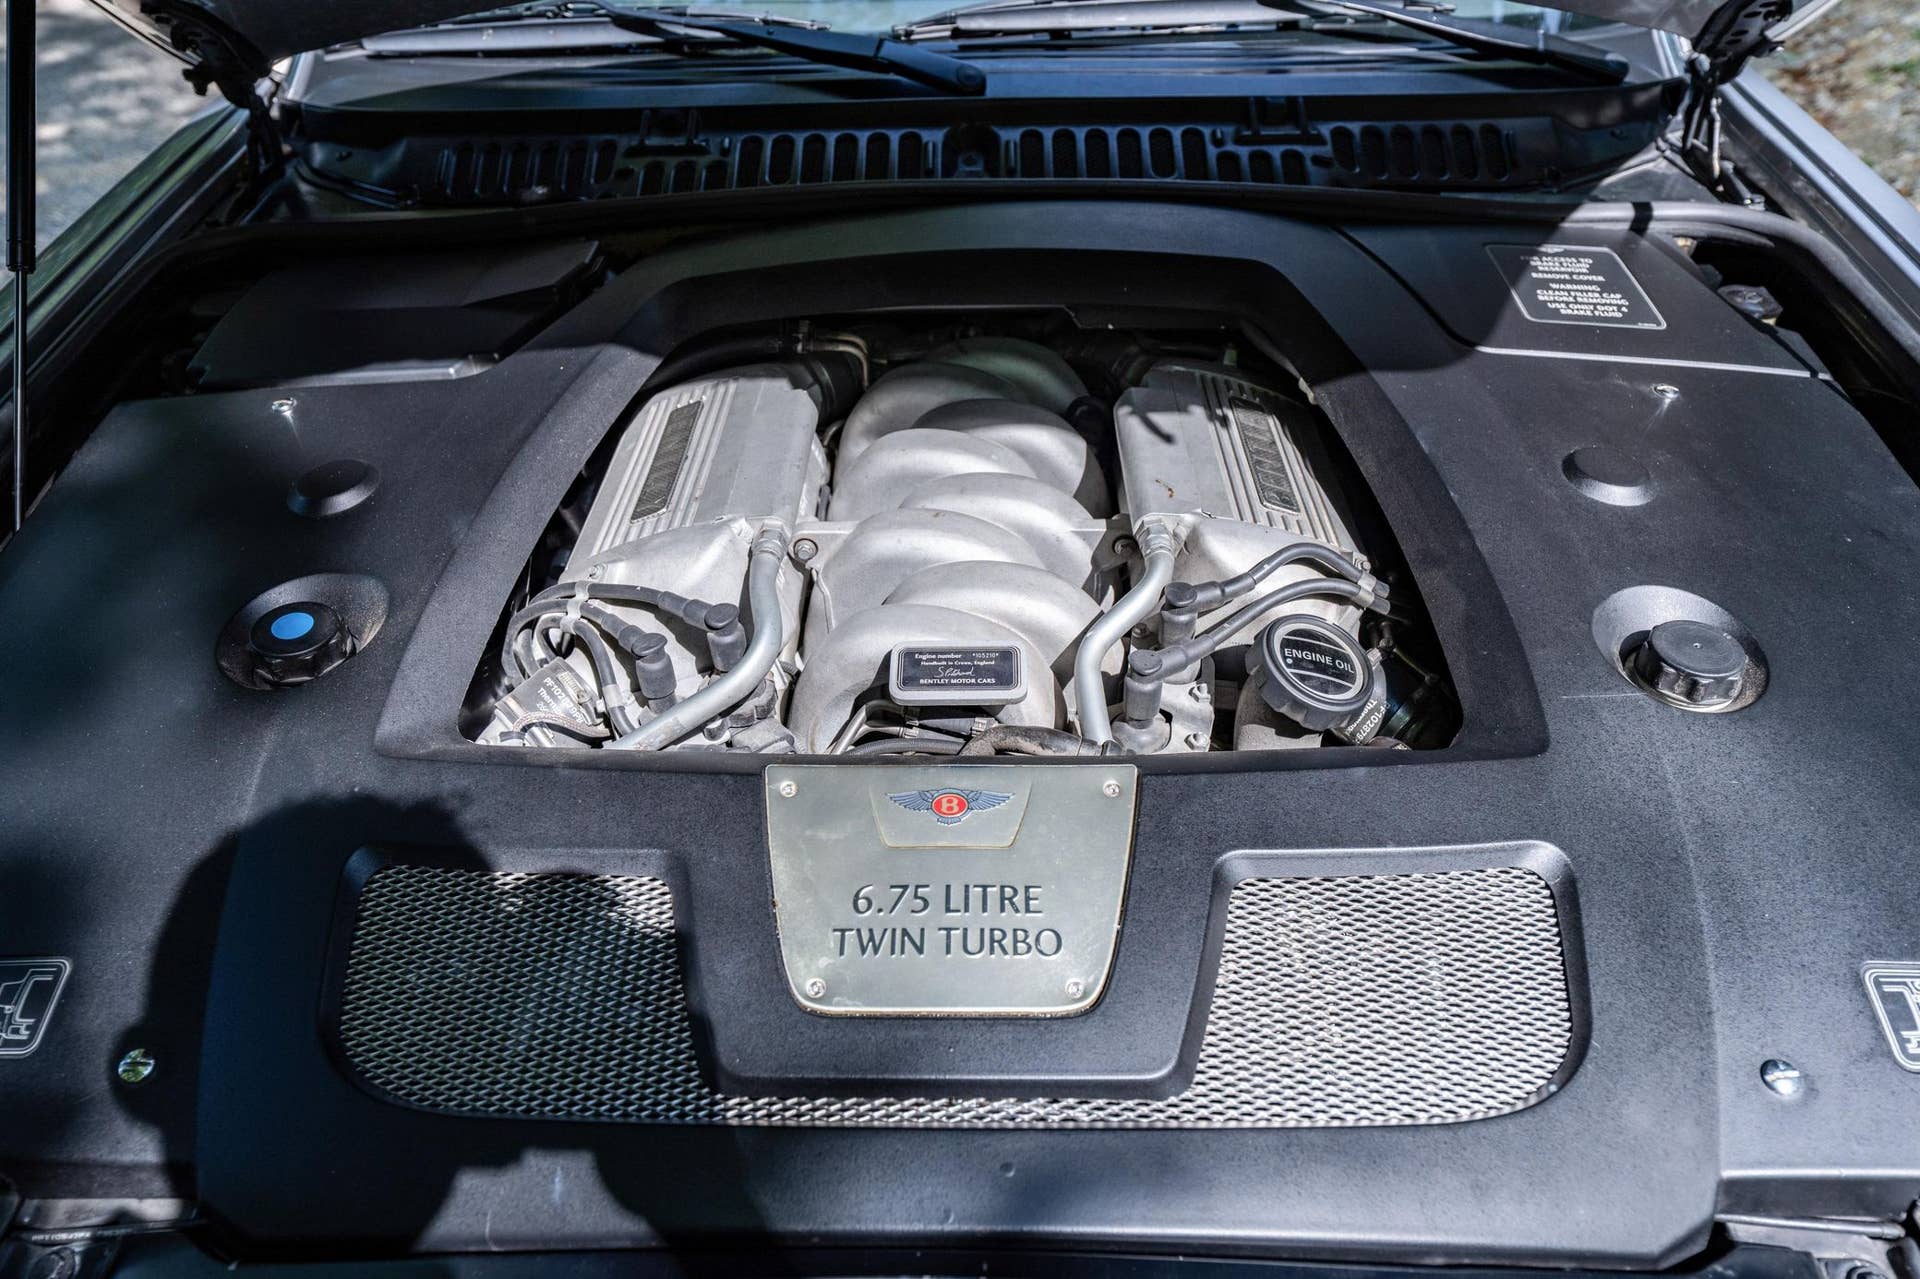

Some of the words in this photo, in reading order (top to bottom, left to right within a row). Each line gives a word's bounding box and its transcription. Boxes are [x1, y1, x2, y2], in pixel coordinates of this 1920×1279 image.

[1537, 265, 1590, 273] RESERVOIR
[1531, 272, 1571, 280] REMOVE
[1549, 283, 1600, 291] WARNING
[1570, 290, 1601, 298] FILLER
[1577, 297, 1629, 305] REMOVING
[1568, 303, 1594, 311] ONLY
[1593, 310, 1623, 318] FLUID
[1284, 648, 1333, 666] ENGINE
[1335, 660, 1355, 673] OIL
[852, 884, 930, 915] 6.75
[944, 884, 1043, 915] LITRE
[832, 928, 926, 958] TWIN
[937, 928, 1063, 958] TURBO
